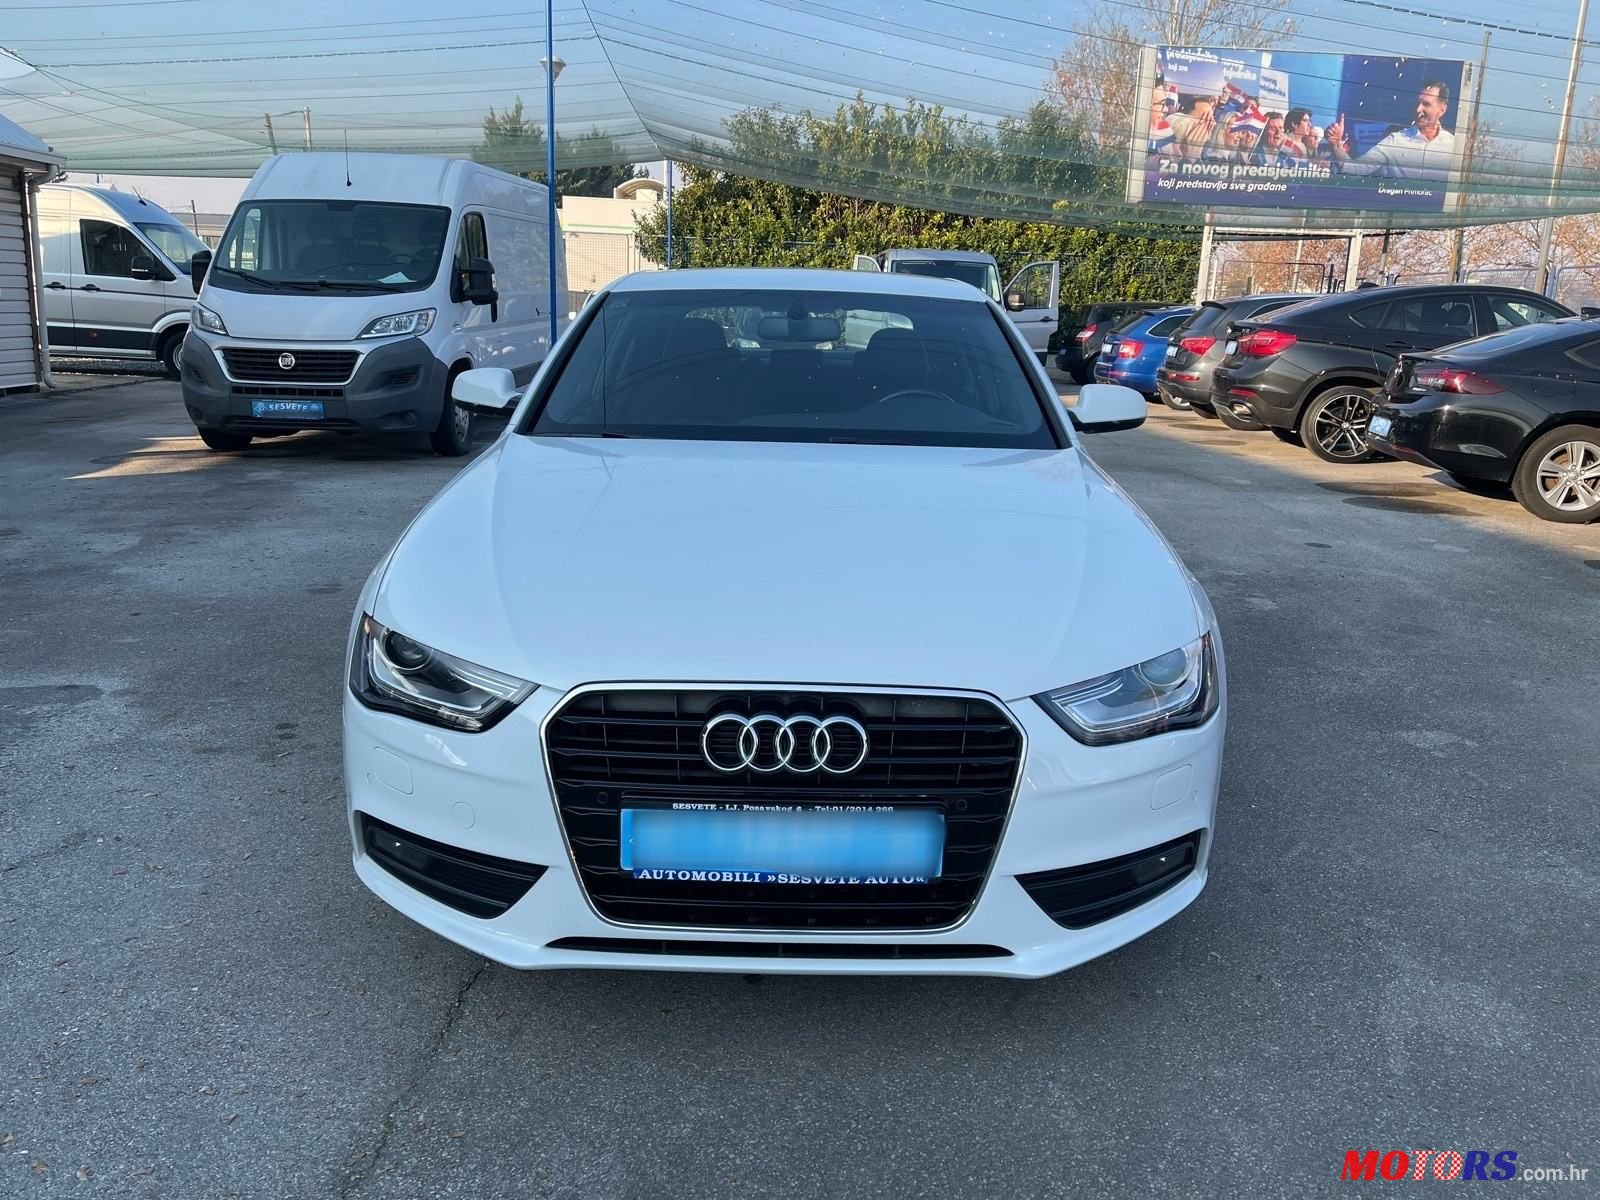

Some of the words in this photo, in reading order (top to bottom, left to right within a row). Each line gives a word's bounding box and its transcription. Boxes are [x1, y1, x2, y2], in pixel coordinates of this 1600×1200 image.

[1159, 159, 1178, 173] Za
[1182, 163, 1229, 179] novog
[1232, 163, 1330, 180] predsjednika
[1157, 178, 1174, 188] koji
[1176, 180, 1227, 192] predstavlja
[1230, 182, 1245, 190] sve
[672, 803, 717, 811] SESVETE
[743, 804, 793, 813] Posavskog
[638, 869, 761, 883] AUTOMOBILI
